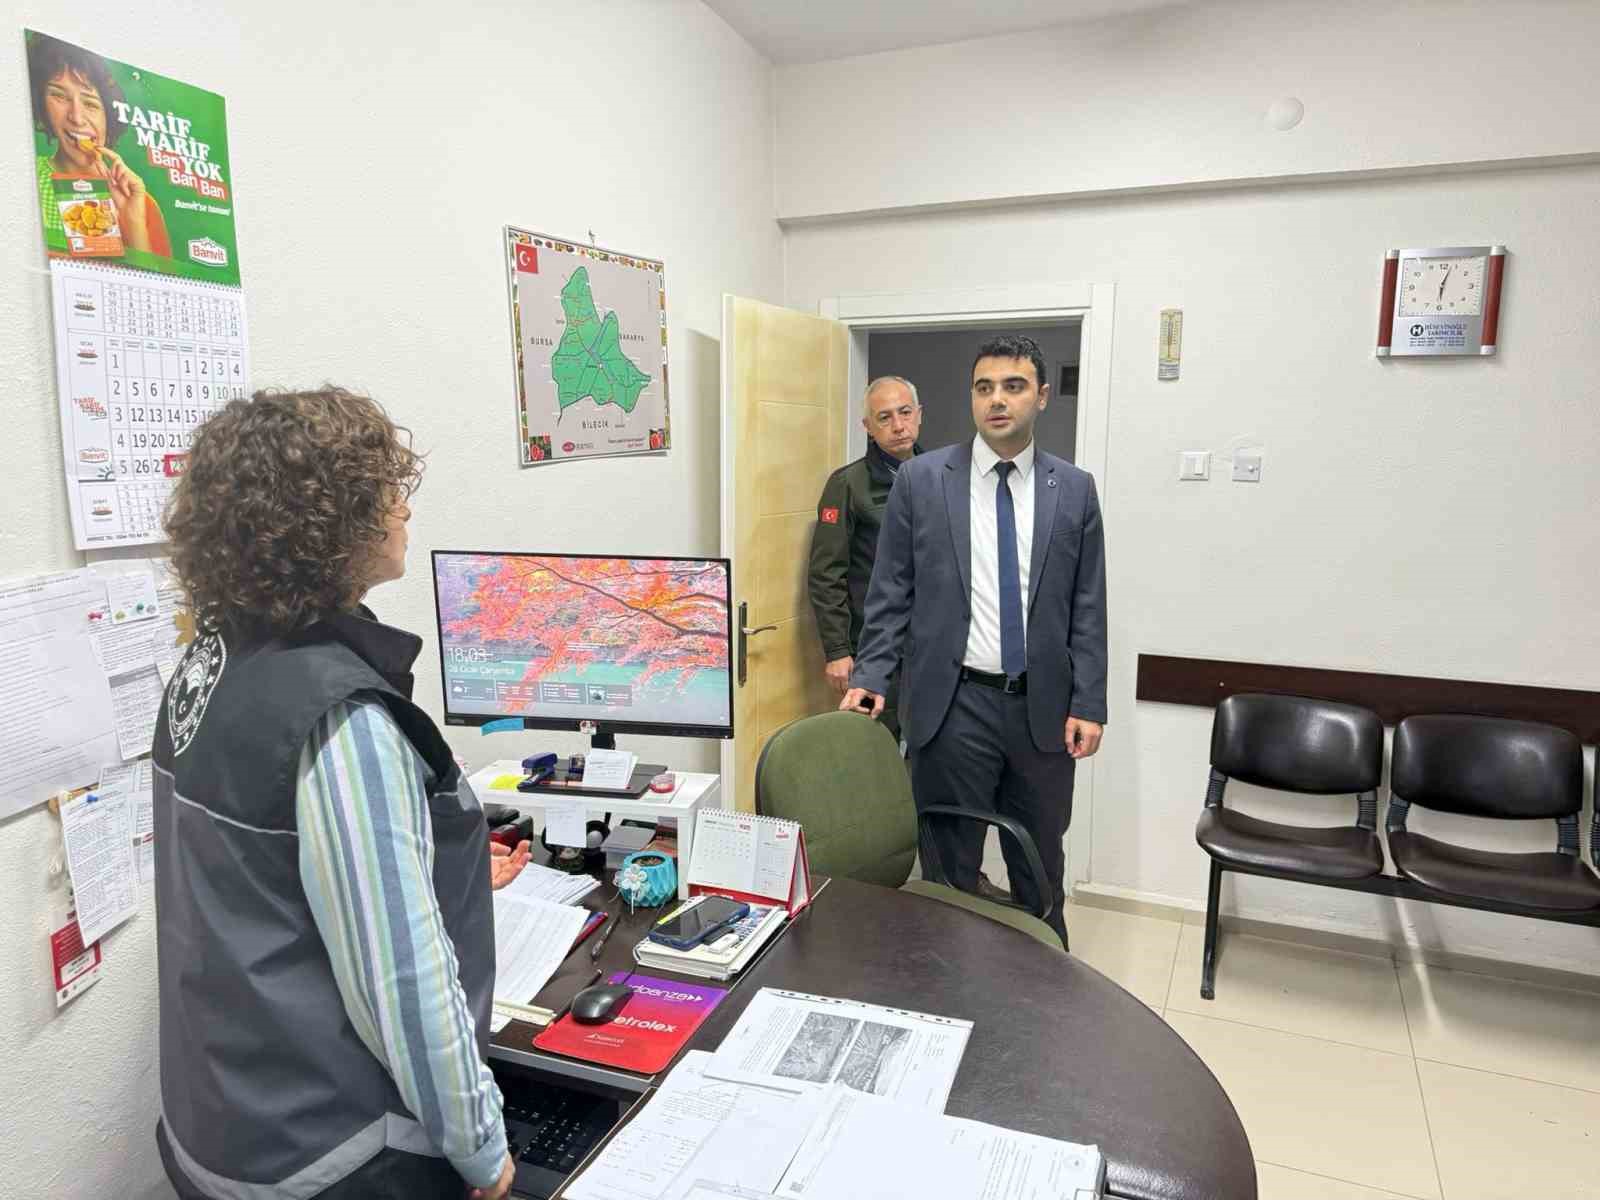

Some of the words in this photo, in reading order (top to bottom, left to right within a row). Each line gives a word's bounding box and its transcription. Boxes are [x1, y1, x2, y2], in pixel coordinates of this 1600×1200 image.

[112, 100, 192, 138] TARİF
[136, 126, 210, 160] MARİF
[151, 149, 181, 168] Ban
[180, 157, 224, 182] YOK
[170, 168, 198, 188] Ban
[200, 180, 226, 200] Ban
[192, 245, 224, 261] Banvit
[113, 354, 119, 368] 1
[185, 360, 190, 373] 1
[201, 361, 208, 375] 2
[217, 362, 224, 376] 3
[233, 364, 240, 376] 4
[113, 380, 120, 395] 2
[132, 382, 139, 396] 5
[150, 382, 158, 397] 6
[169, 384, 175, 397] 7
[186, 385, 192, 398] 8
[202, 385, 209, 399] 9
[217, 386, 229, 399] 10
[232, 387, 243, 400] 11
[115, 407, 122, 422] 3
[131, 407, 144, 422] 12
[150, 409, 163, 423] 13
[168, 409, 180, 422] 14
[185, 409, 197, 423] 15
[117, 433, 124, 448] 4
[133, 434, 147, 448] 19
[151, 434, 165, 448] 20
[169, 434, 182, 448] 21
[120, 460, 127, 474] 5
[136, 459, 149, 474] 26
[613, 1016, 678, 1033] etrolex
